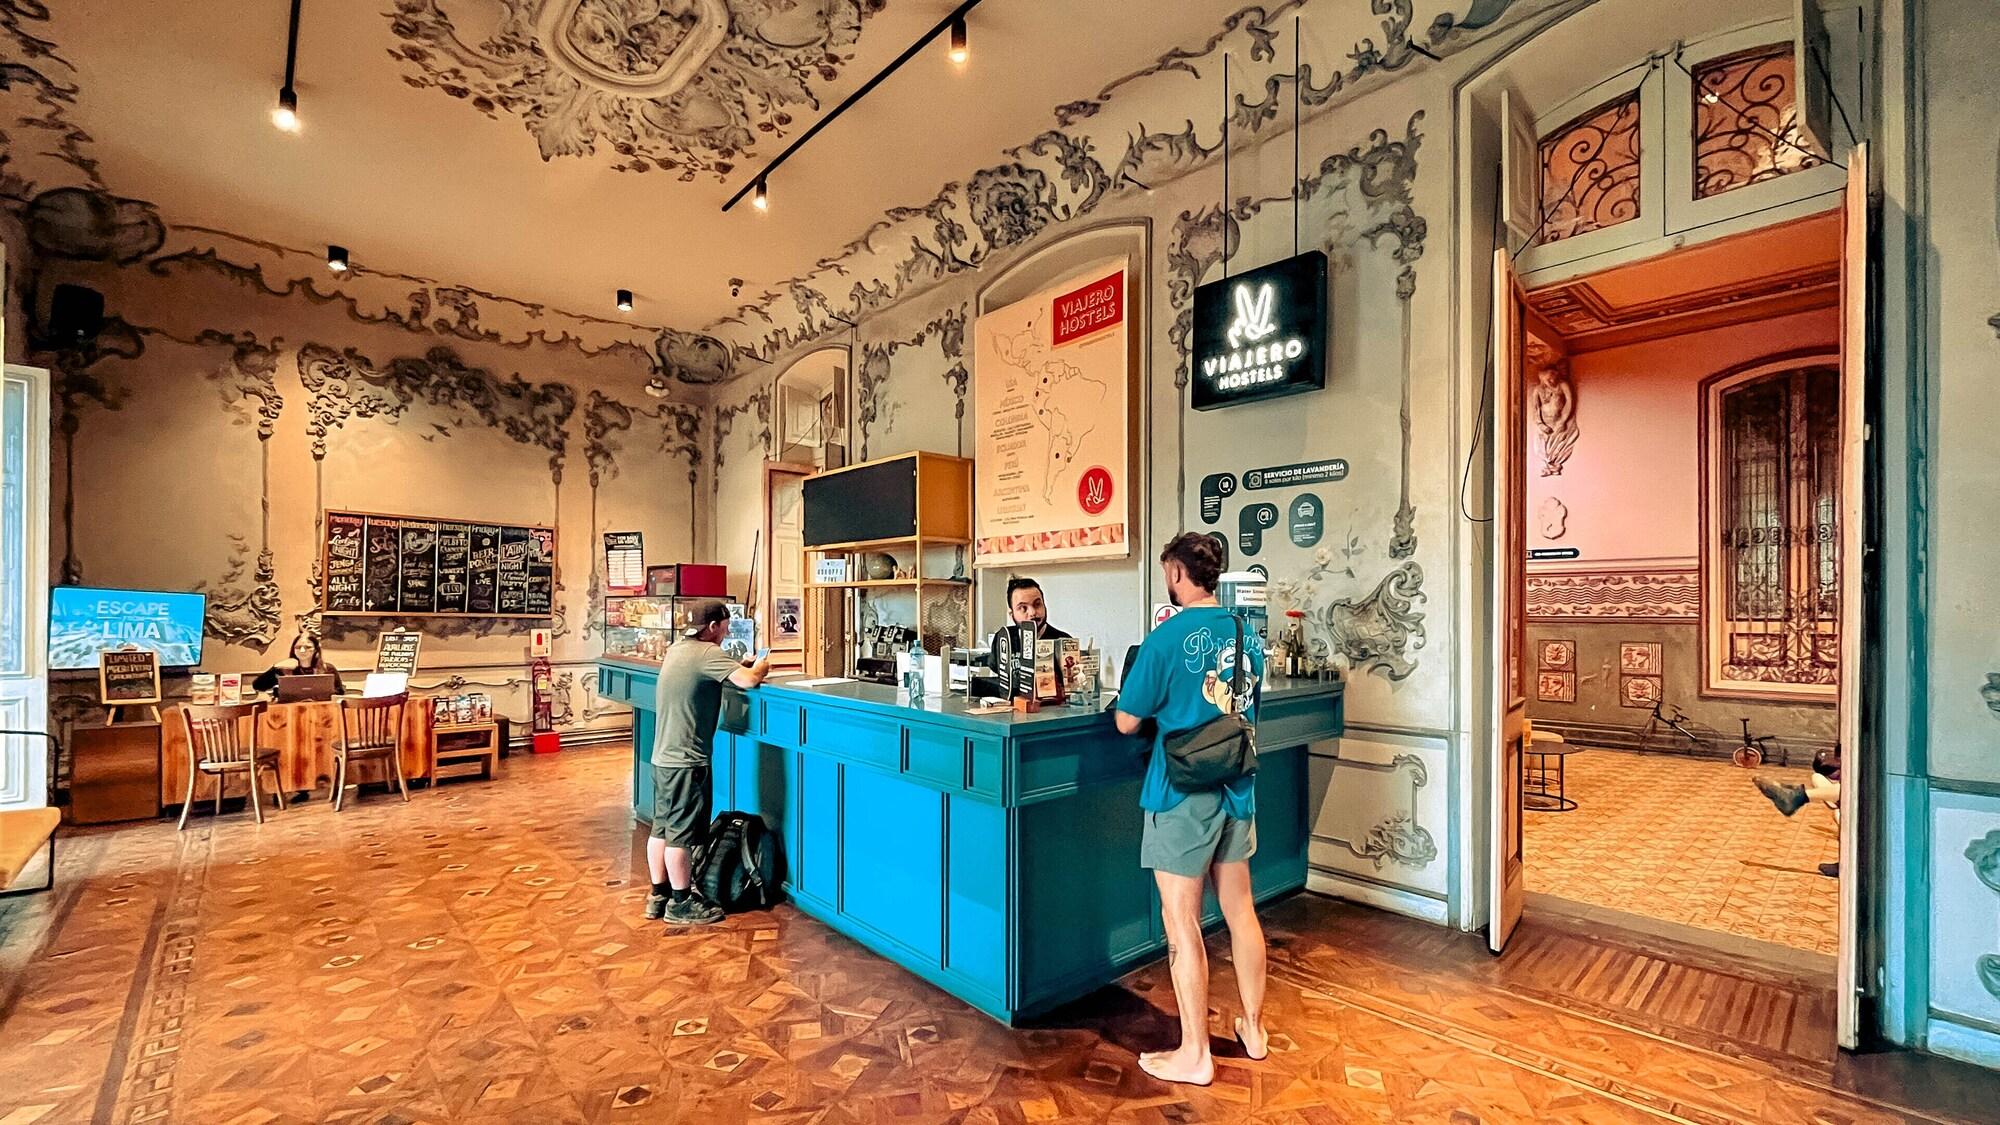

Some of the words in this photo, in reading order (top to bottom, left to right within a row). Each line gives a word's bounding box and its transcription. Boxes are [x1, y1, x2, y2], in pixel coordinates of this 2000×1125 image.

[1061, 285, 1114, 318] VIAJERO
[1060, 302, 1115, 336] HOSTELS
[1204, 339, 1302, 377] VIAJERO
[1219, 364, 1283, 390] HOSTELS
[1264, 469, 1292, 479] SERVICIO
[1303, 462, 1344, 474] LAVANDERÍA
[368, 518, 398, 529] Tuesday
[329, 560, 354, 569] JENGA
[501, 562, 523, 570] NIGHT
[329, 584, 357, 592] NIGHT
[97, 600, 169, 615] ESCAPE
[103, 620, 160, 638] LIMA
[109, 654, 145, 663] LIMITED
